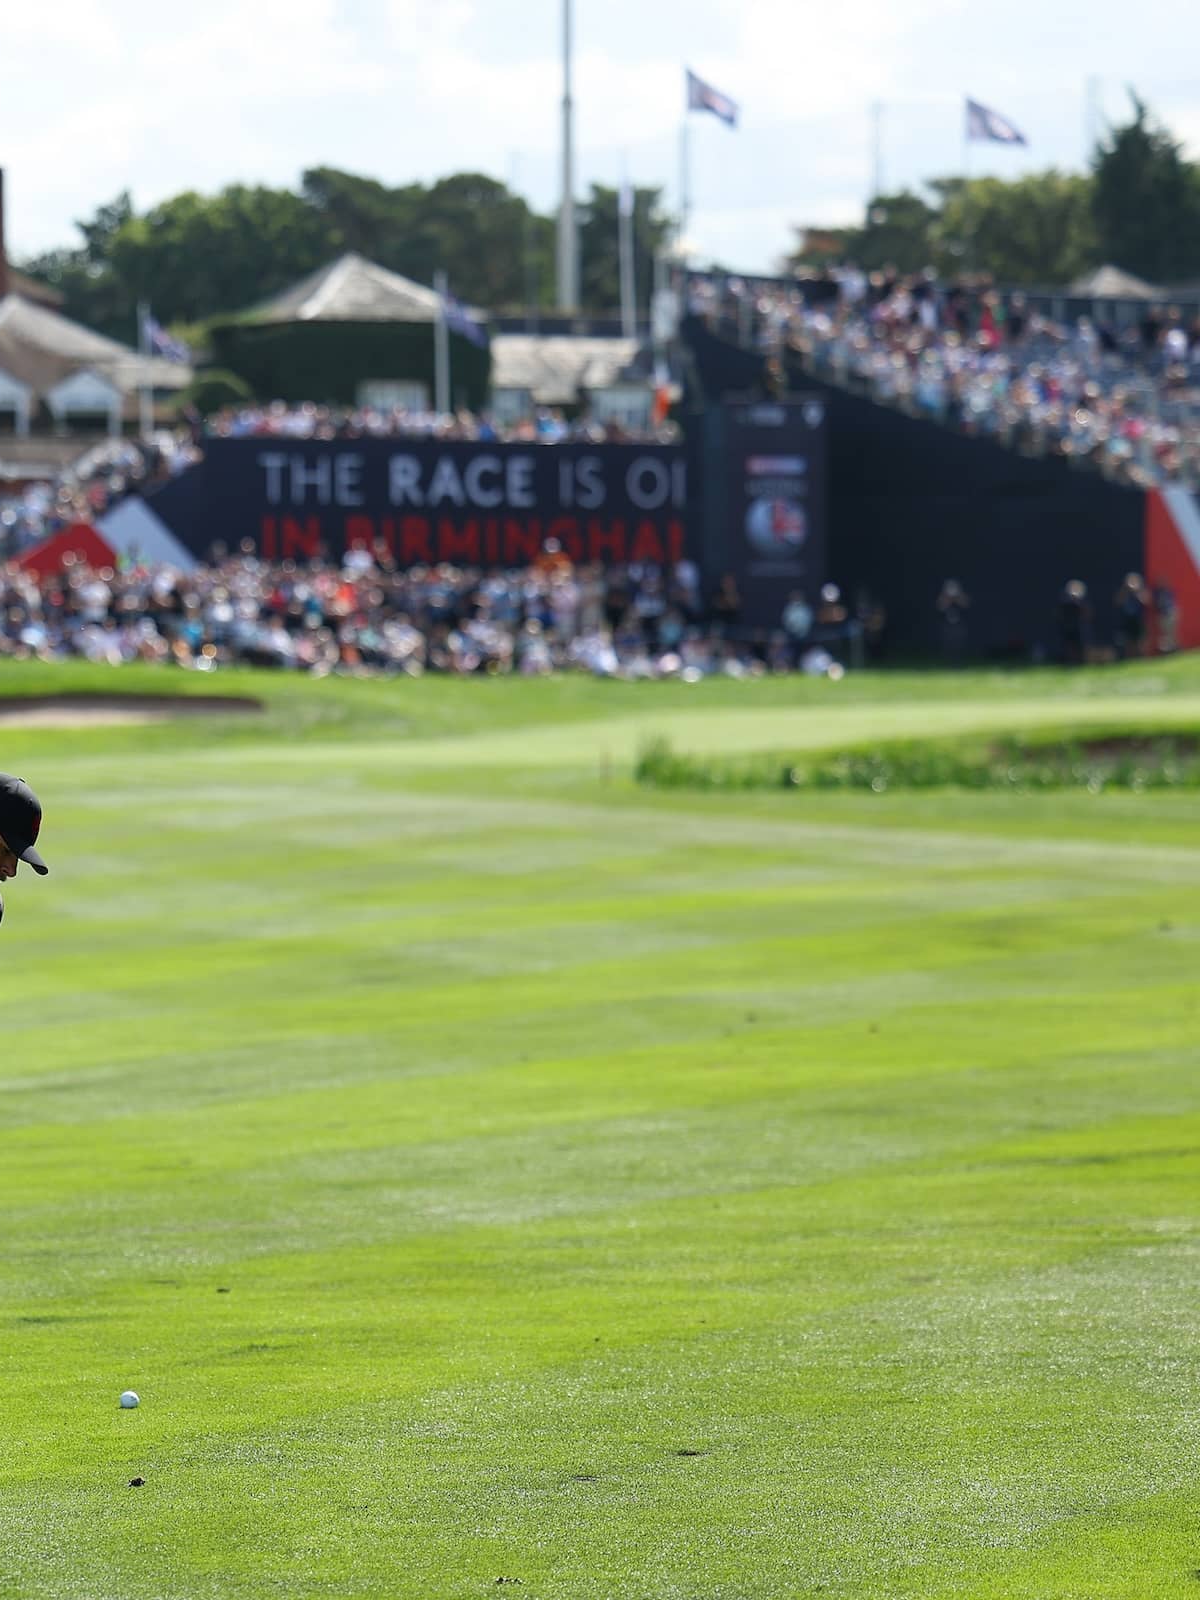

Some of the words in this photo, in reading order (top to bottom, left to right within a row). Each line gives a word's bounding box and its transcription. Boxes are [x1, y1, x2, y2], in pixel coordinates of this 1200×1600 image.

[259, 453, 364, 506] THE
[389, 454, 536, 508] RACE
[560, 456, 606, 510] IS
[261, 514, 319, 559] IN
